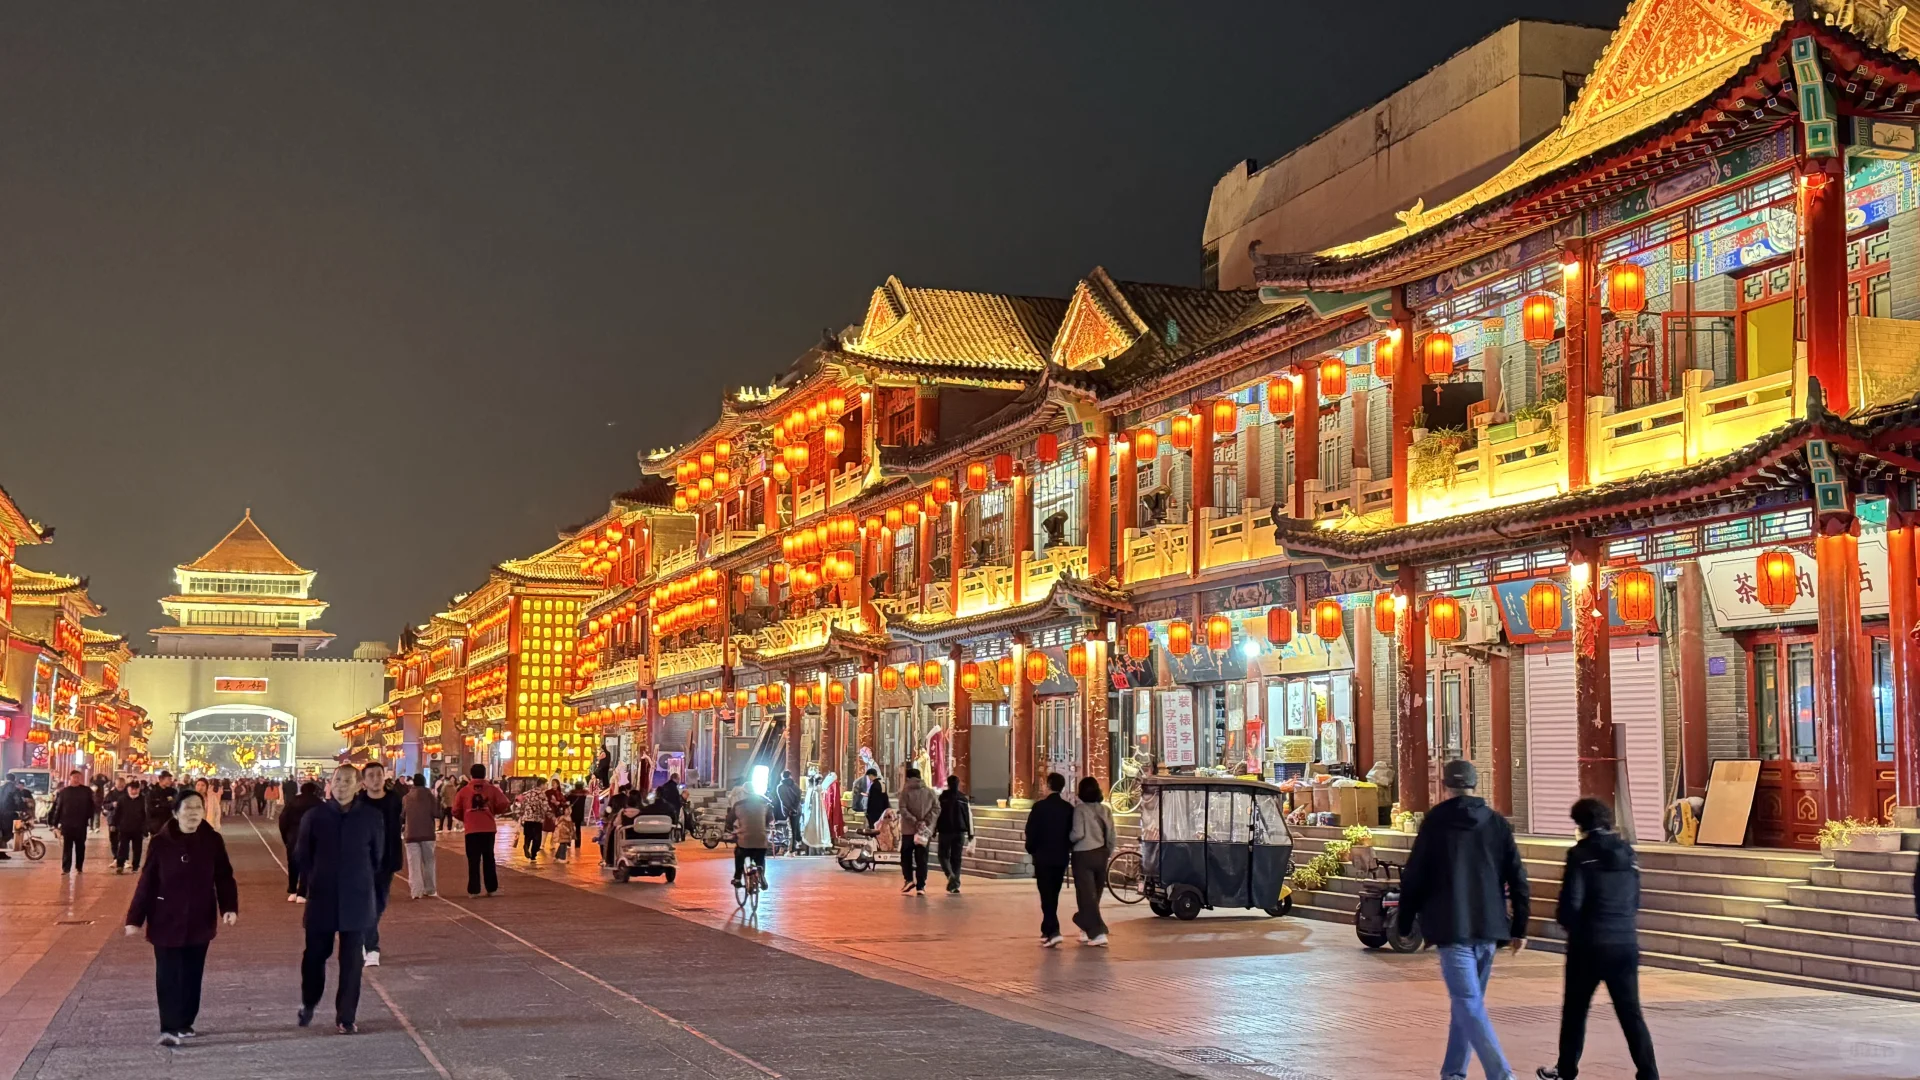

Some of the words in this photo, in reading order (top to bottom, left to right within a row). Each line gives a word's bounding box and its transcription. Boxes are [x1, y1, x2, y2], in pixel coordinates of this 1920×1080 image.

[1164, 694, 1178, 762] 十字绣配框
[1178, 694, 1193, 762] 装裱字画
